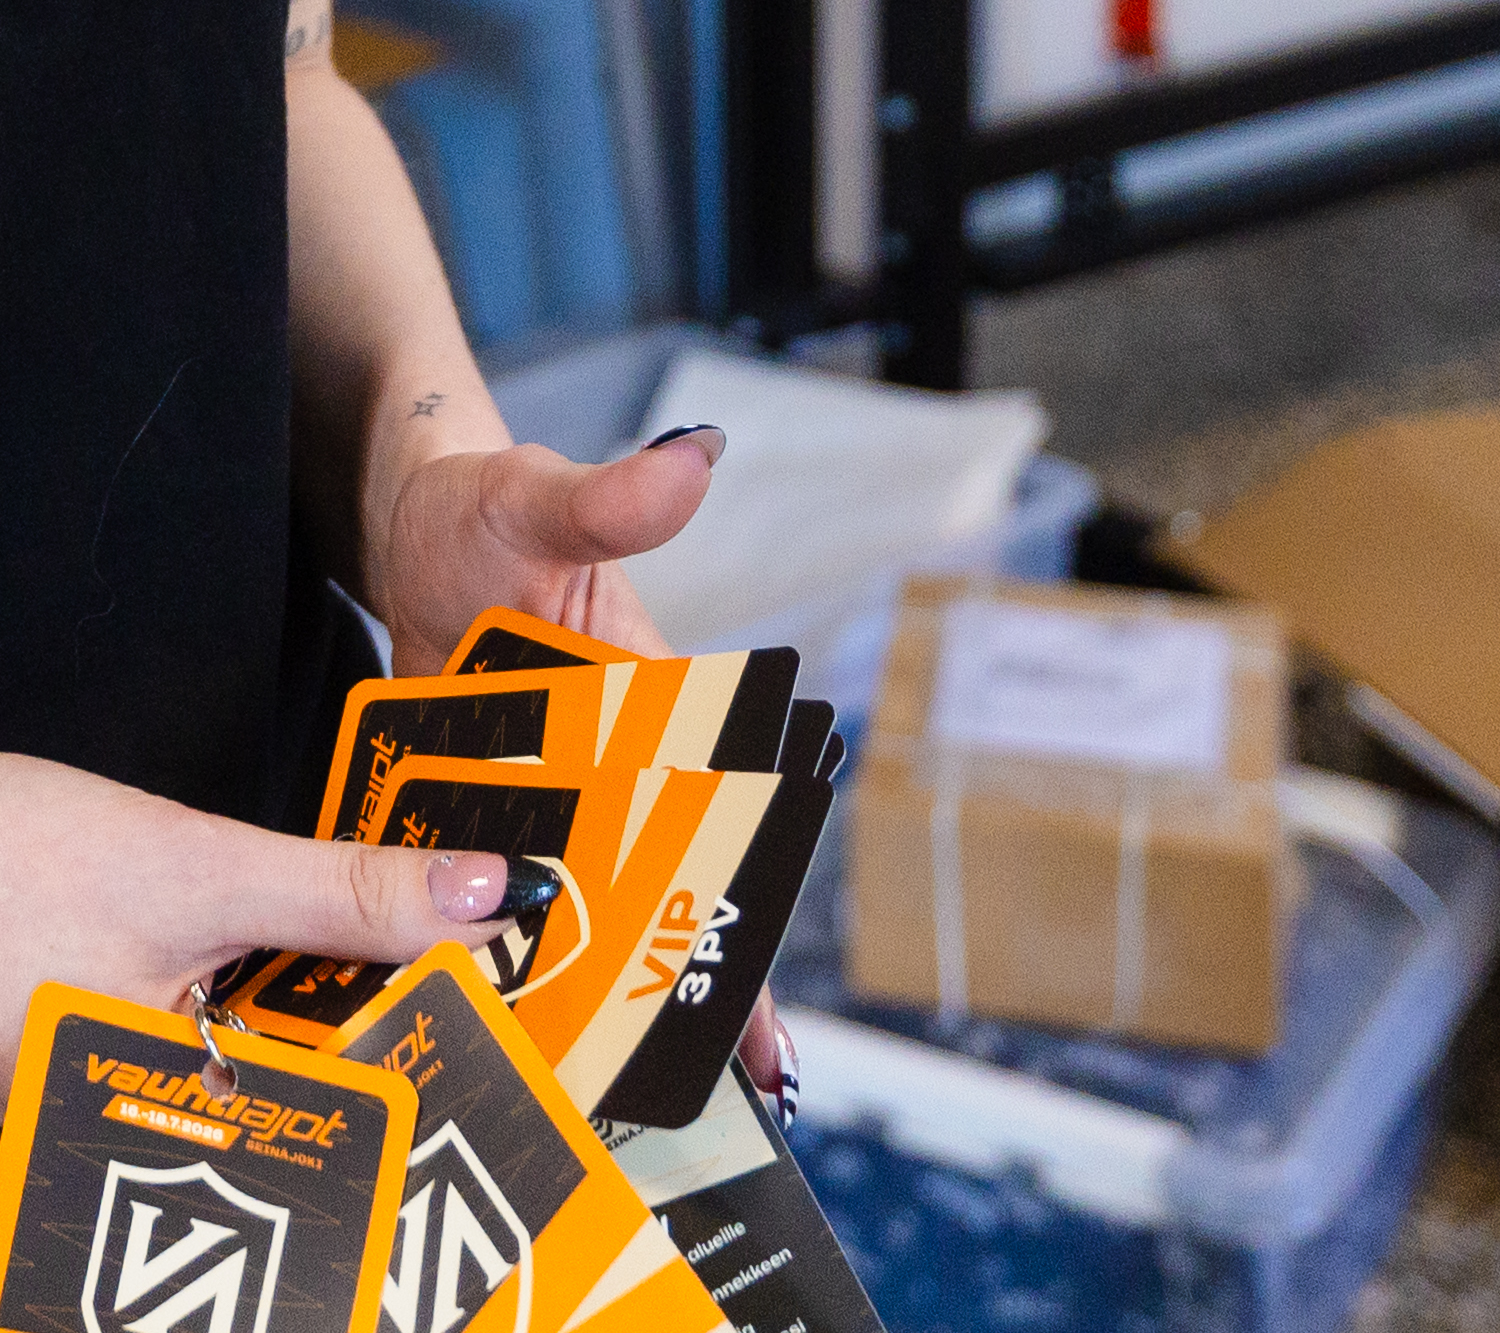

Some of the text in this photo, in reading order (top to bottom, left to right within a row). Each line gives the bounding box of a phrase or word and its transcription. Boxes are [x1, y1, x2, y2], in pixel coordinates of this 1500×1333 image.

[626, 888, 699, 1002] VIP
[677, 895, 740, 1004] 3 PV
[711, 1247, 795, 1302] nnekkeen
